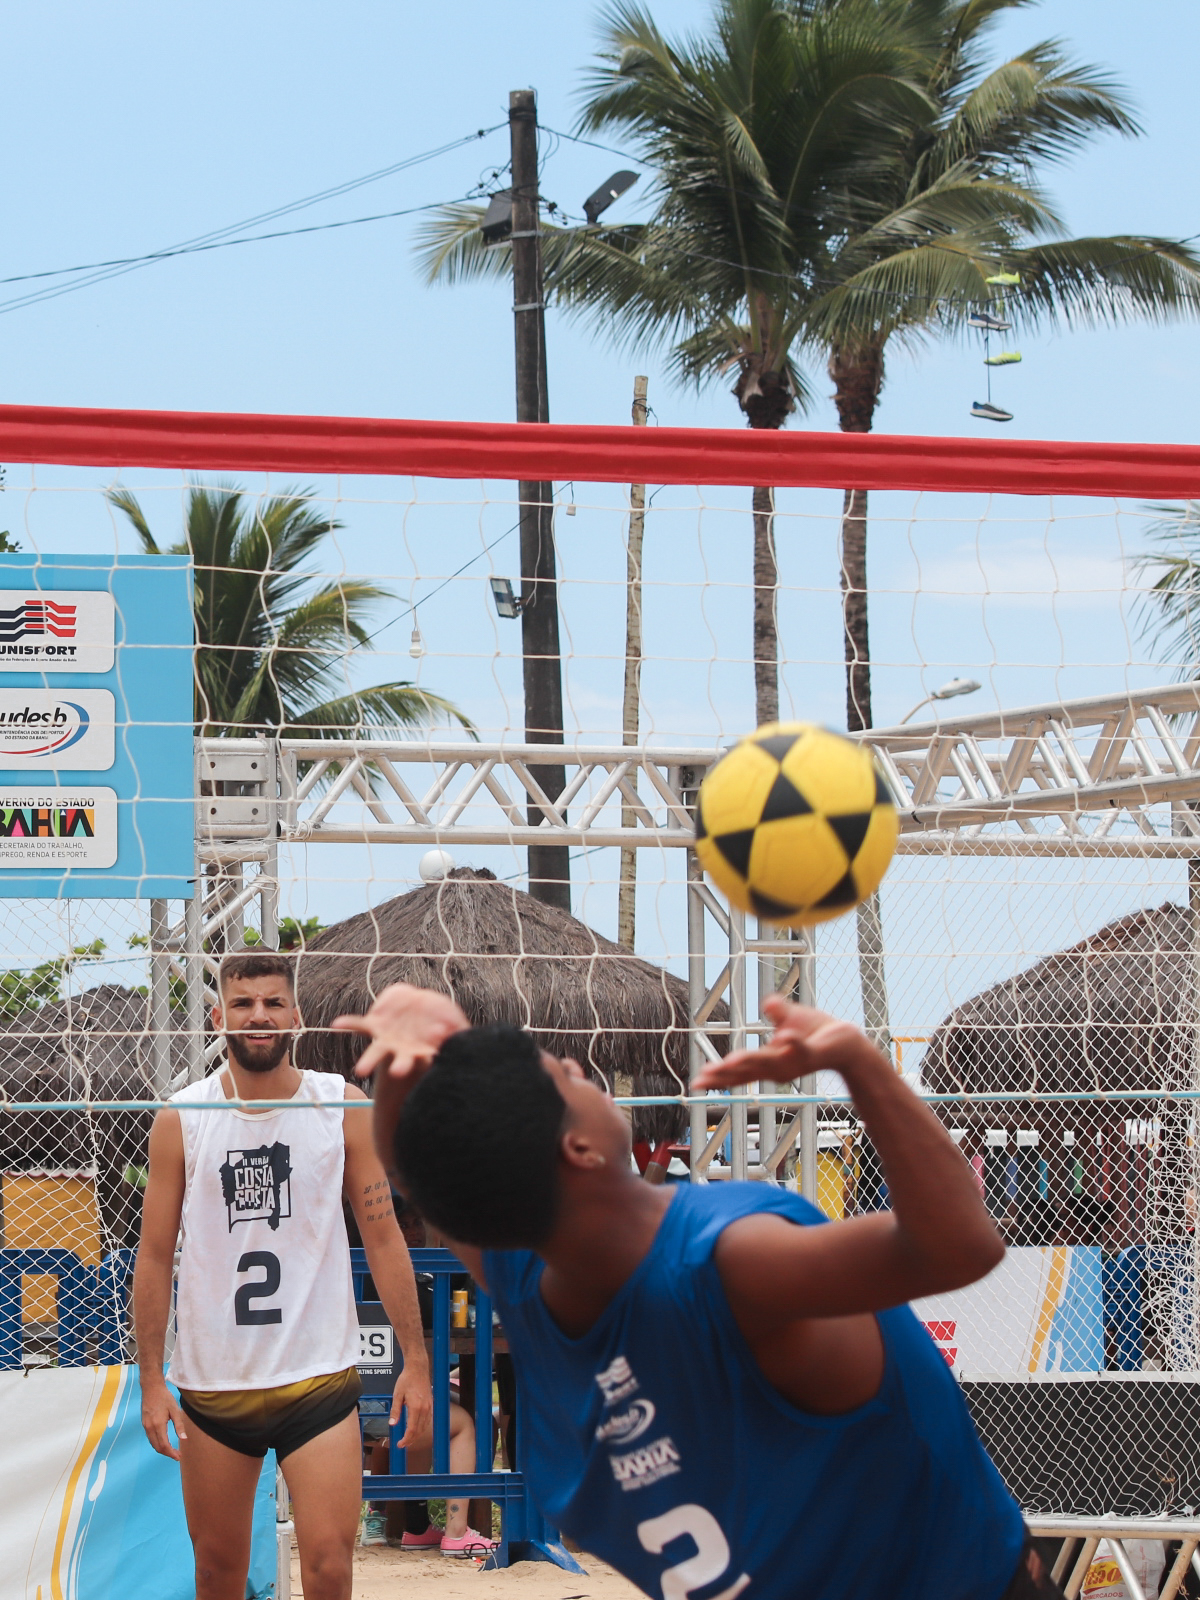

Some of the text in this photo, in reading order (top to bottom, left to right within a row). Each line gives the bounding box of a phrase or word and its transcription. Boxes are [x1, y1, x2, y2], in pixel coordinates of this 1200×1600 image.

[38, 797, 53, 807] DO
[56, 797, 95, 807] ESTADO
[234, 1164, 274, 1190] COSTA
[234, 1187, 276, 1211] COSTA
[234, 1251, 282, 1326] 2
[360, 1333, 385, 1357] S
[637, 1504, 751, 1600] 2
